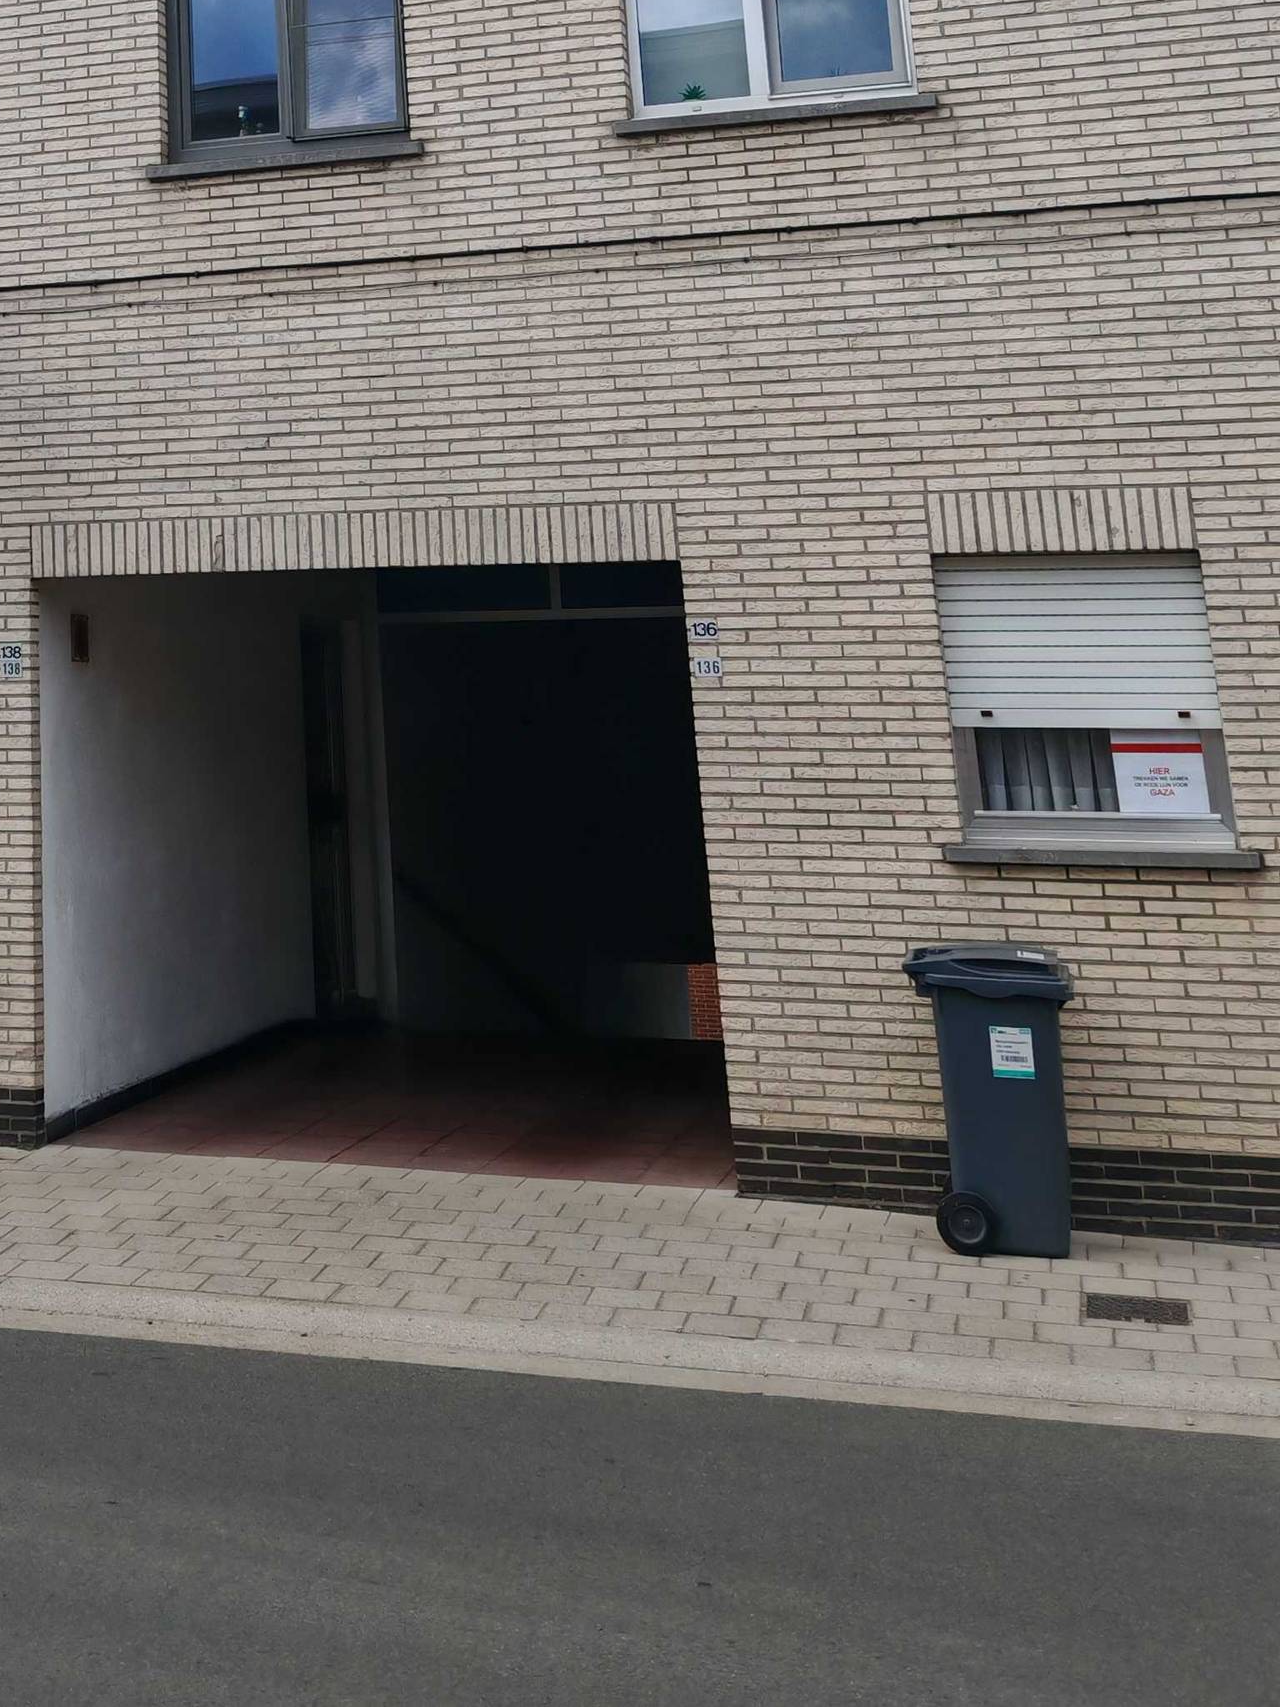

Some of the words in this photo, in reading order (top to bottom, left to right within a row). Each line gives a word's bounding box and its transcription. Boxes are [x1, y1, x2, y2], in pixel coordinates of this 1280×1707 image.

[691, 622, 718, 637] 136
[1, 646, 22, 659] 138
[3, 663, 21, 675] 138
[697, 660, 720, 674] 136
[1150, 788, 1175, 796] GAZA
